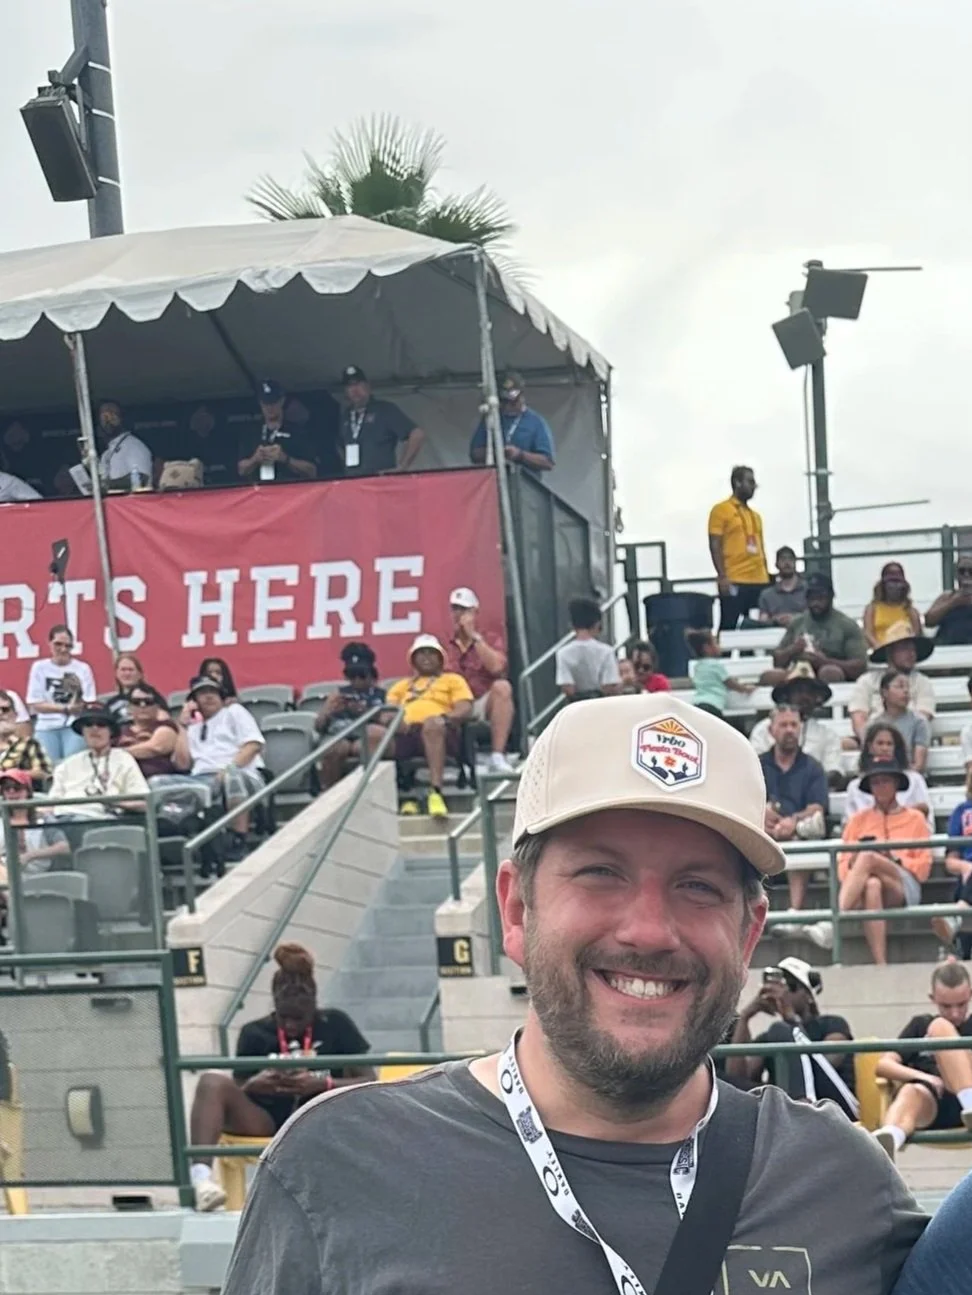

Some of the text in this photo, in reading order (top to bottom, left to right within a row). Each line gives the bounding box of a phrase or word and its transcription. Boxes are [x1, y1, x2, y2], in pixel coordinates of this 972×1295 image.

[181, 555, 424, 649] HERE
[187, 950, 201, 974] F
[453, 939, 470, 964] G
[748, 1269, 791, 1288] VA
